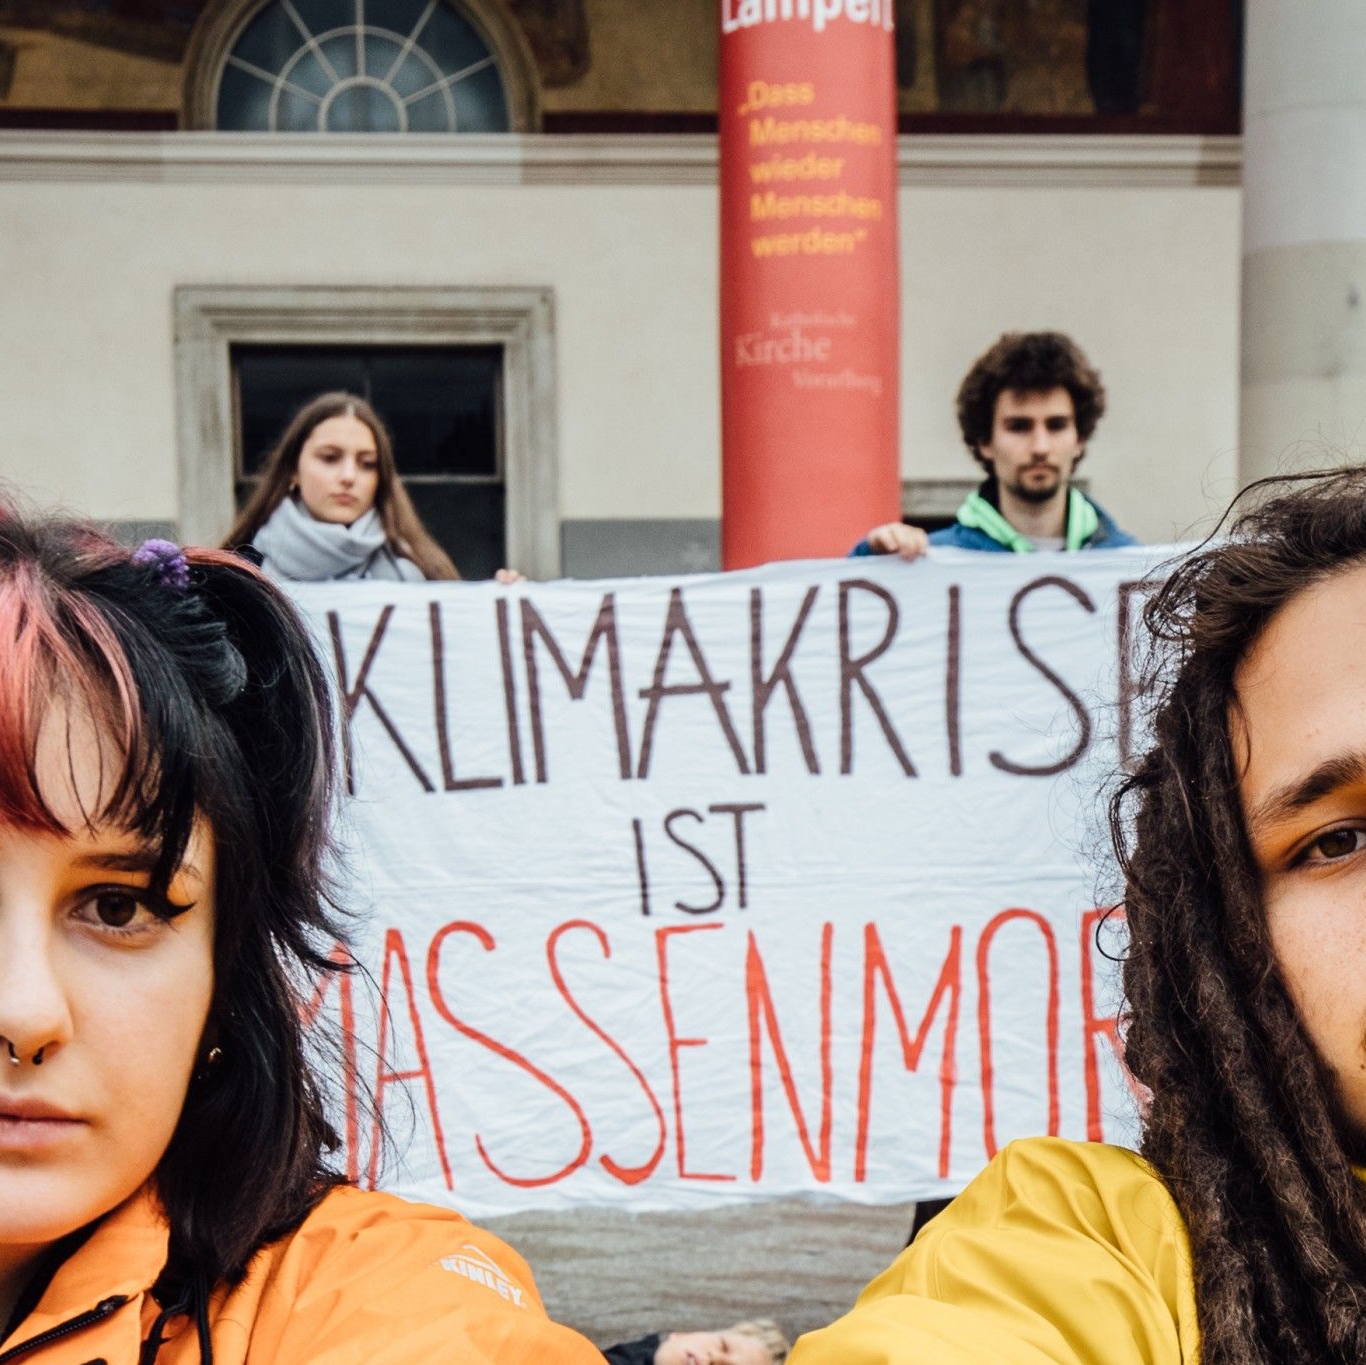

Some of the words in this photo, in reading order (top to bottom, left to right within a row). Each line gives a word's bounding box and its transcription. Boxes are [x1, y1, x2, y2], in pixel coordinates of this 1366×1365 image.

[749, 115, 882, 147] Menschen
[750, 153, 843, 183] wieder
[750, 190, 882, 221] Menschen
[736, 331, 832, 366] Kirche
[327, 576, 1169, 794] KLIMAKRISE
[633, 803, 766, 916] IST
